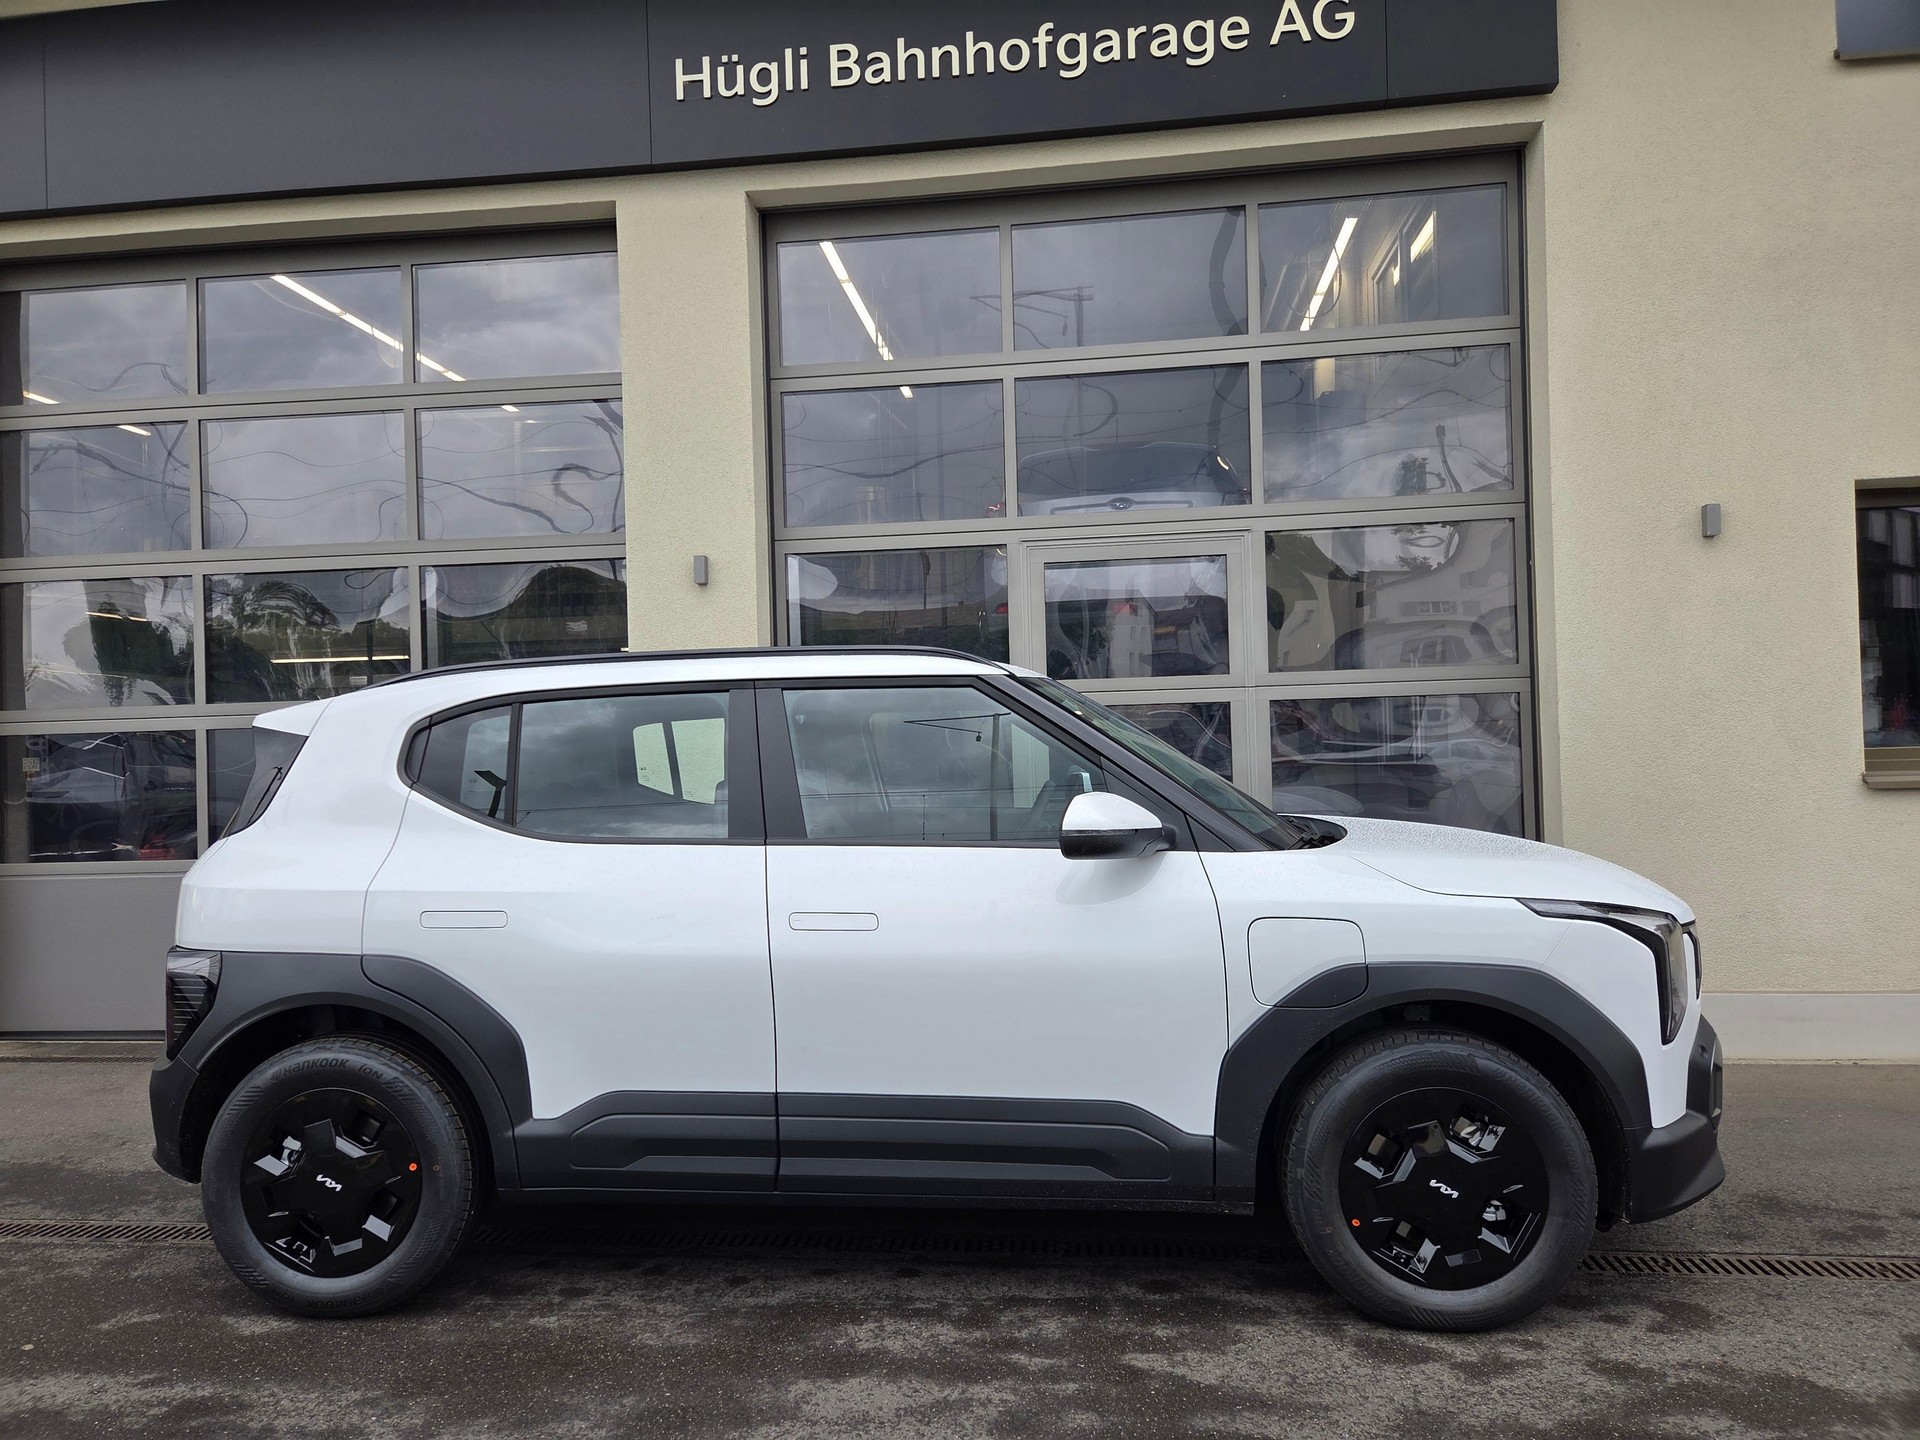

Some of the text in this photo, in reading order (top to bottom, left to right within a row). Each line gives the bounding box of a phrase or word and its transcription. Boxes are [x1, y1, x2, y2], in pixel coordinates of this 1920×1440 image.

[675, 0, 1355, 107] Hügli Bahnhofgarage AG
